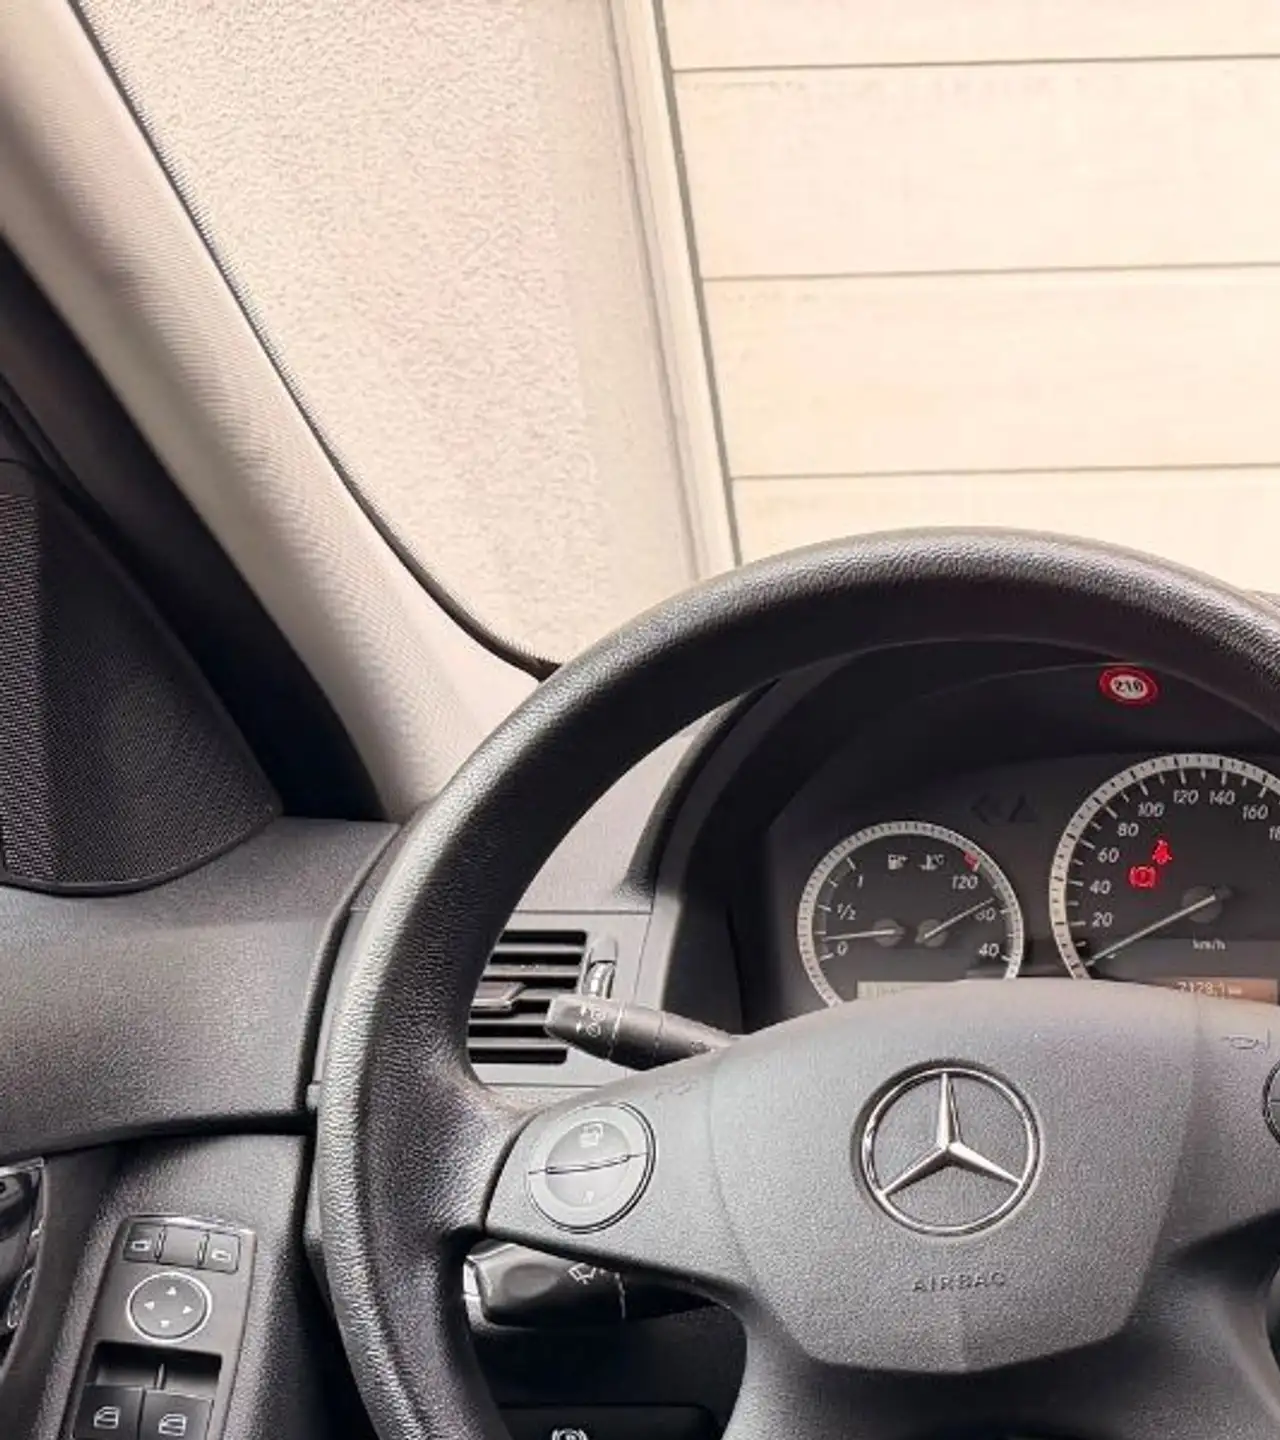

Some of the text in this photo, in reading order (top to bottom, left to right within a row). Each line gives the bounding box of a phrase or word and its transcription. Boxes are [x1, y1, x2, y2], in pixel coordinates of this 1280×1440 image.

[1173, 791, 1199, 804] 120
[1209, 791, 1235, 804] 140
[1137, 803, 1164, 817] 100
[1242, 806, 1268, 820] 160
[1116, 823, 1139, 837] 80
[1098, 848, 1120, 862] 60
[951, 875, 979, 889] 120
[1089, 881, 1112, 895] 40
[1092, 913, 1113, 927] 20
[836, 943, 848, 956] 0
[978, 943, 999, 956] 40
[1192, 937, 1226, 951] km/h
